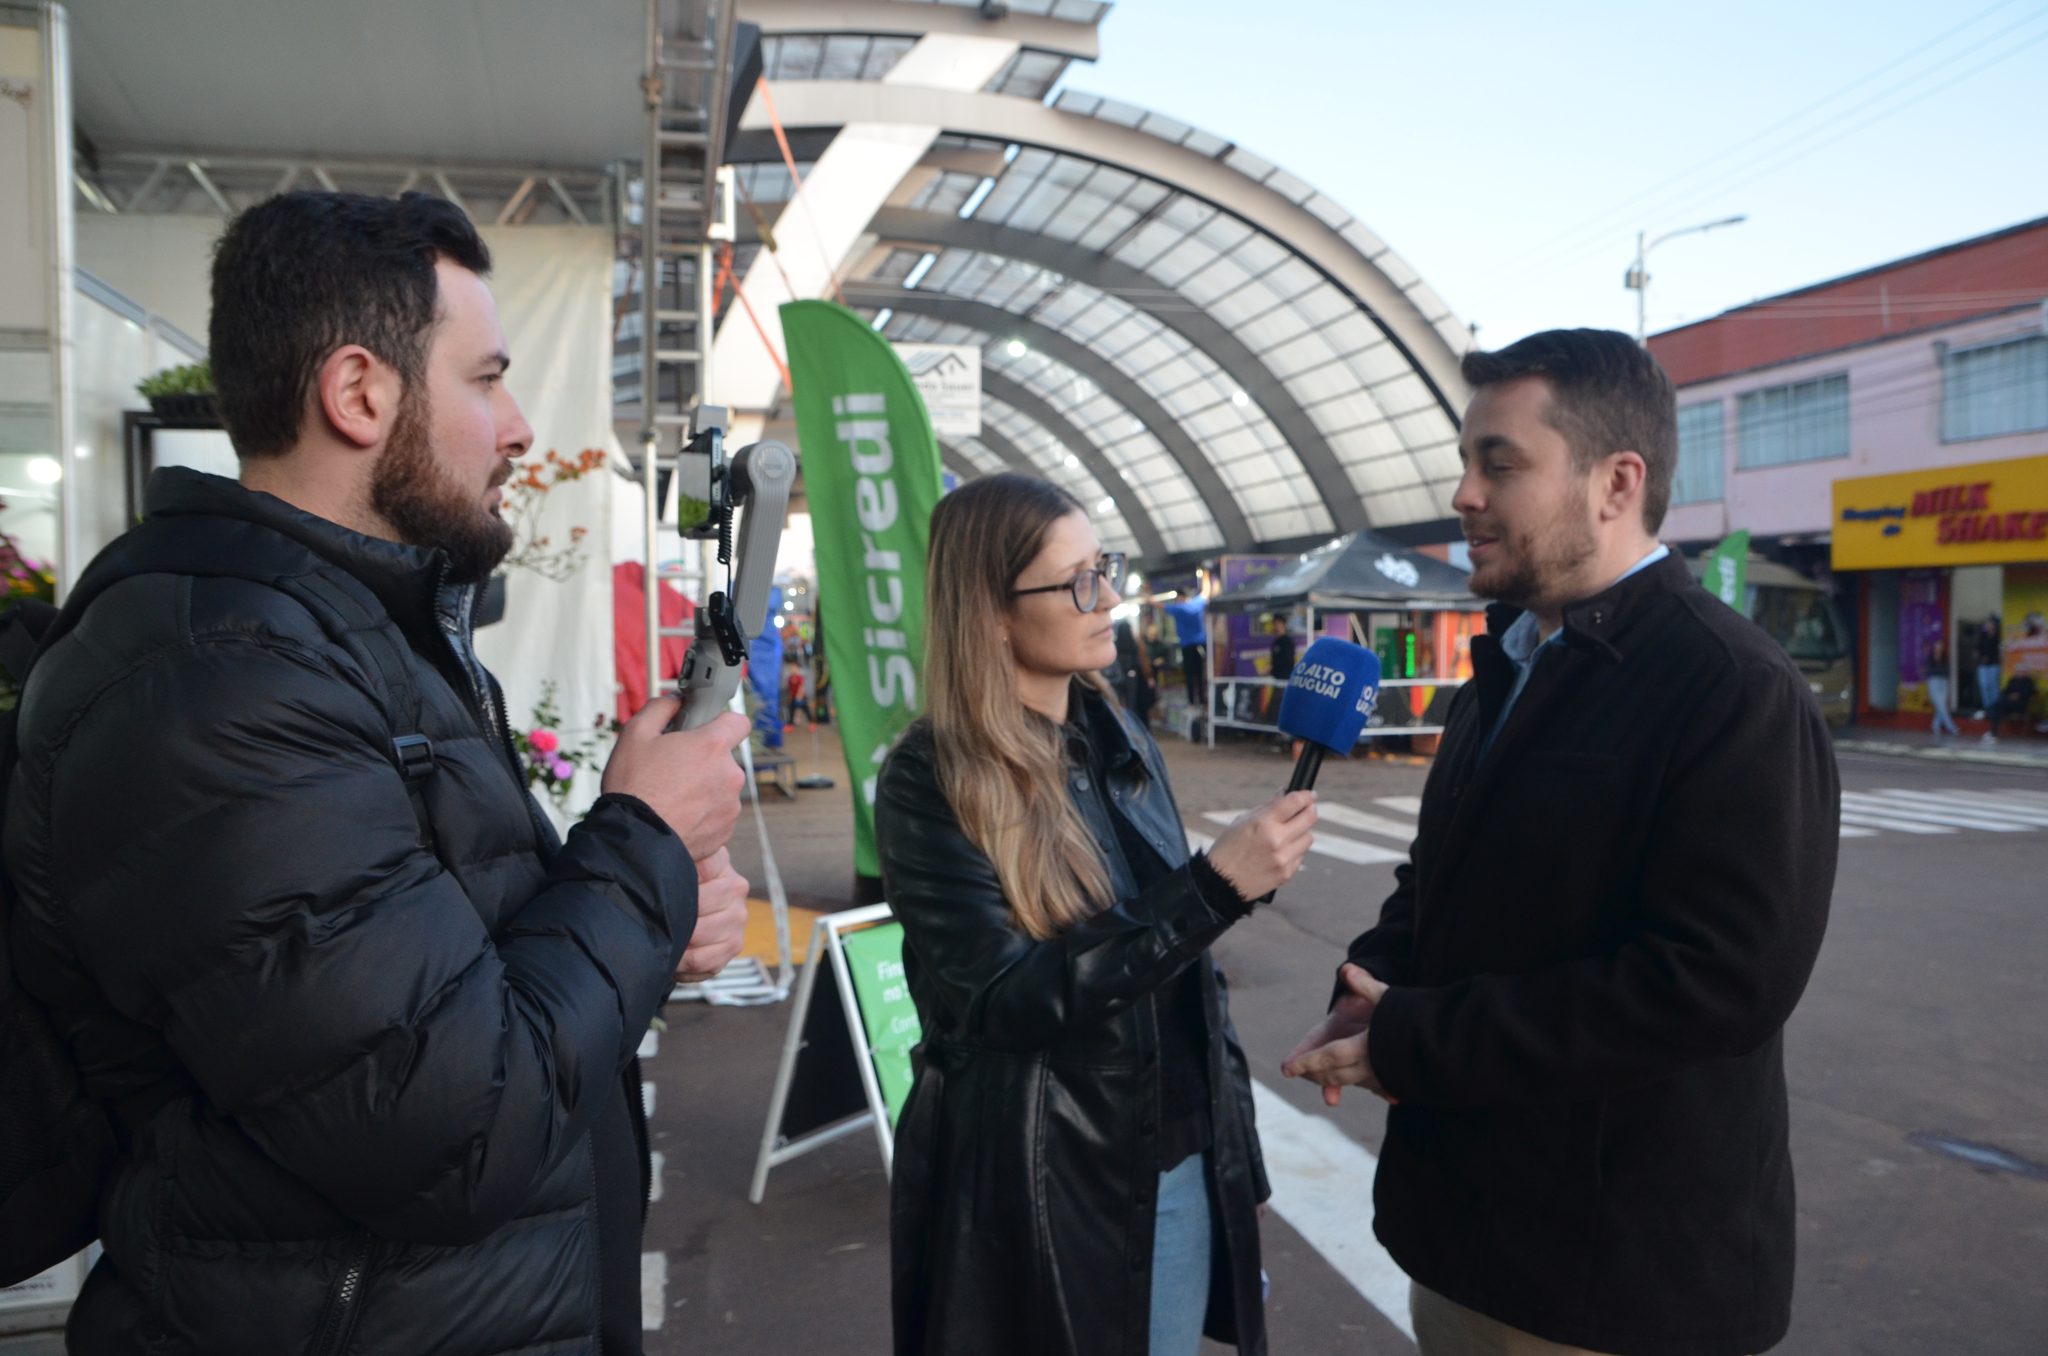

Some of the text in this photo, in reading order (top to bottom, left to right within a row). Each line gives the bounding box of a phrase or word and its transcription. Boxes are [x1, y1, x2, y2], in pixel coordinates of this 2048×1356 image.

[1911, 482, 1992, 518] MILK
[1936, 511, 2048, 545] SHAKE
[832, 393, 917, 712] Sicredi
[1304, 663, 1346, 686] ALTO
